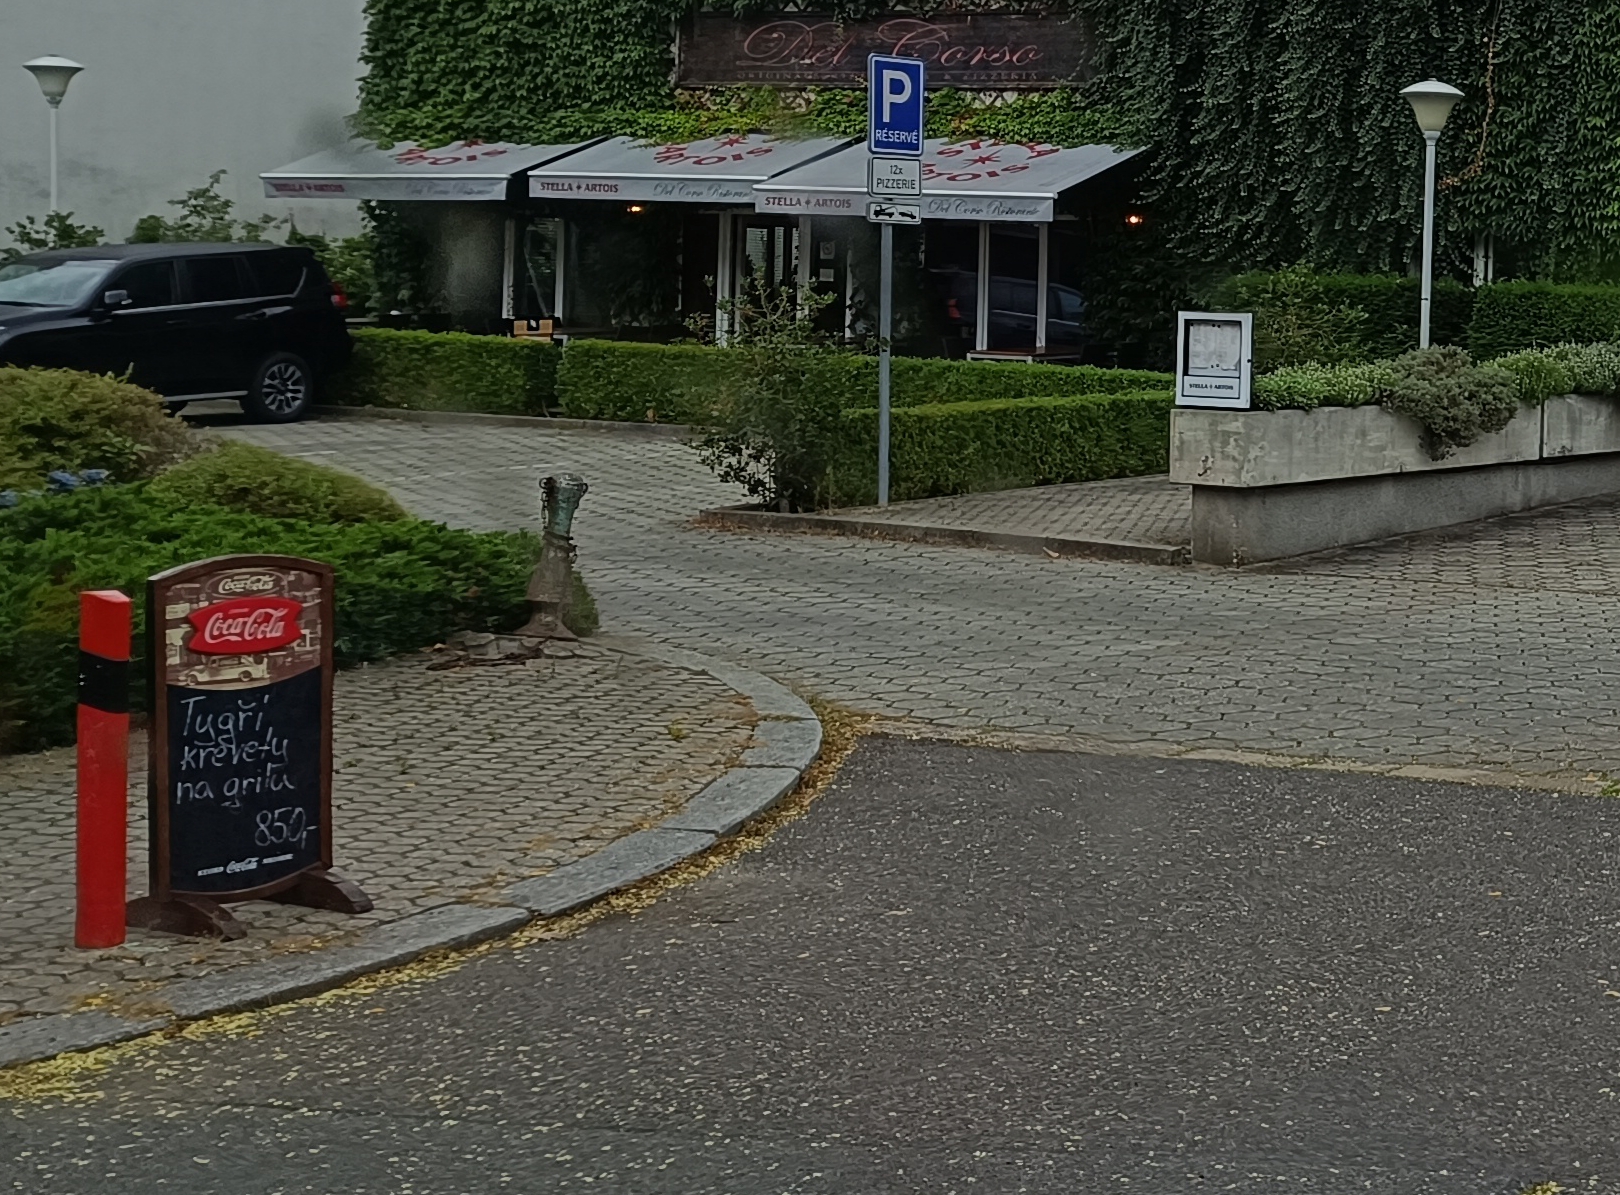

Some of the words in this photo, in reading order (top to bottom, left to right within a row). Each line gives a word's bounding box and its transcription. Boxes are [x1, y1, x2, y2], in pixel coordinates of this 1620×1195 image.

[736, 20, 857, 67] Del
[877, 18, 1044, 67] Corso
[882, 69, 912, 123] P
[875, 127, 919, 145] RÉSERVÉ
[889, 164, 904, 175] 12x
[540, 182, 573, 192] STELLA
[584, 183, 619, 193] ARTOIS
[876, 177, 917, 191] PIZZERIE
[764, 195, 802, 207] STELLA
[813, 197, 852, 209] ARTOIS
[204, 608, 290, 644] Coca-Cola
[176, 781, 215, 805] na
